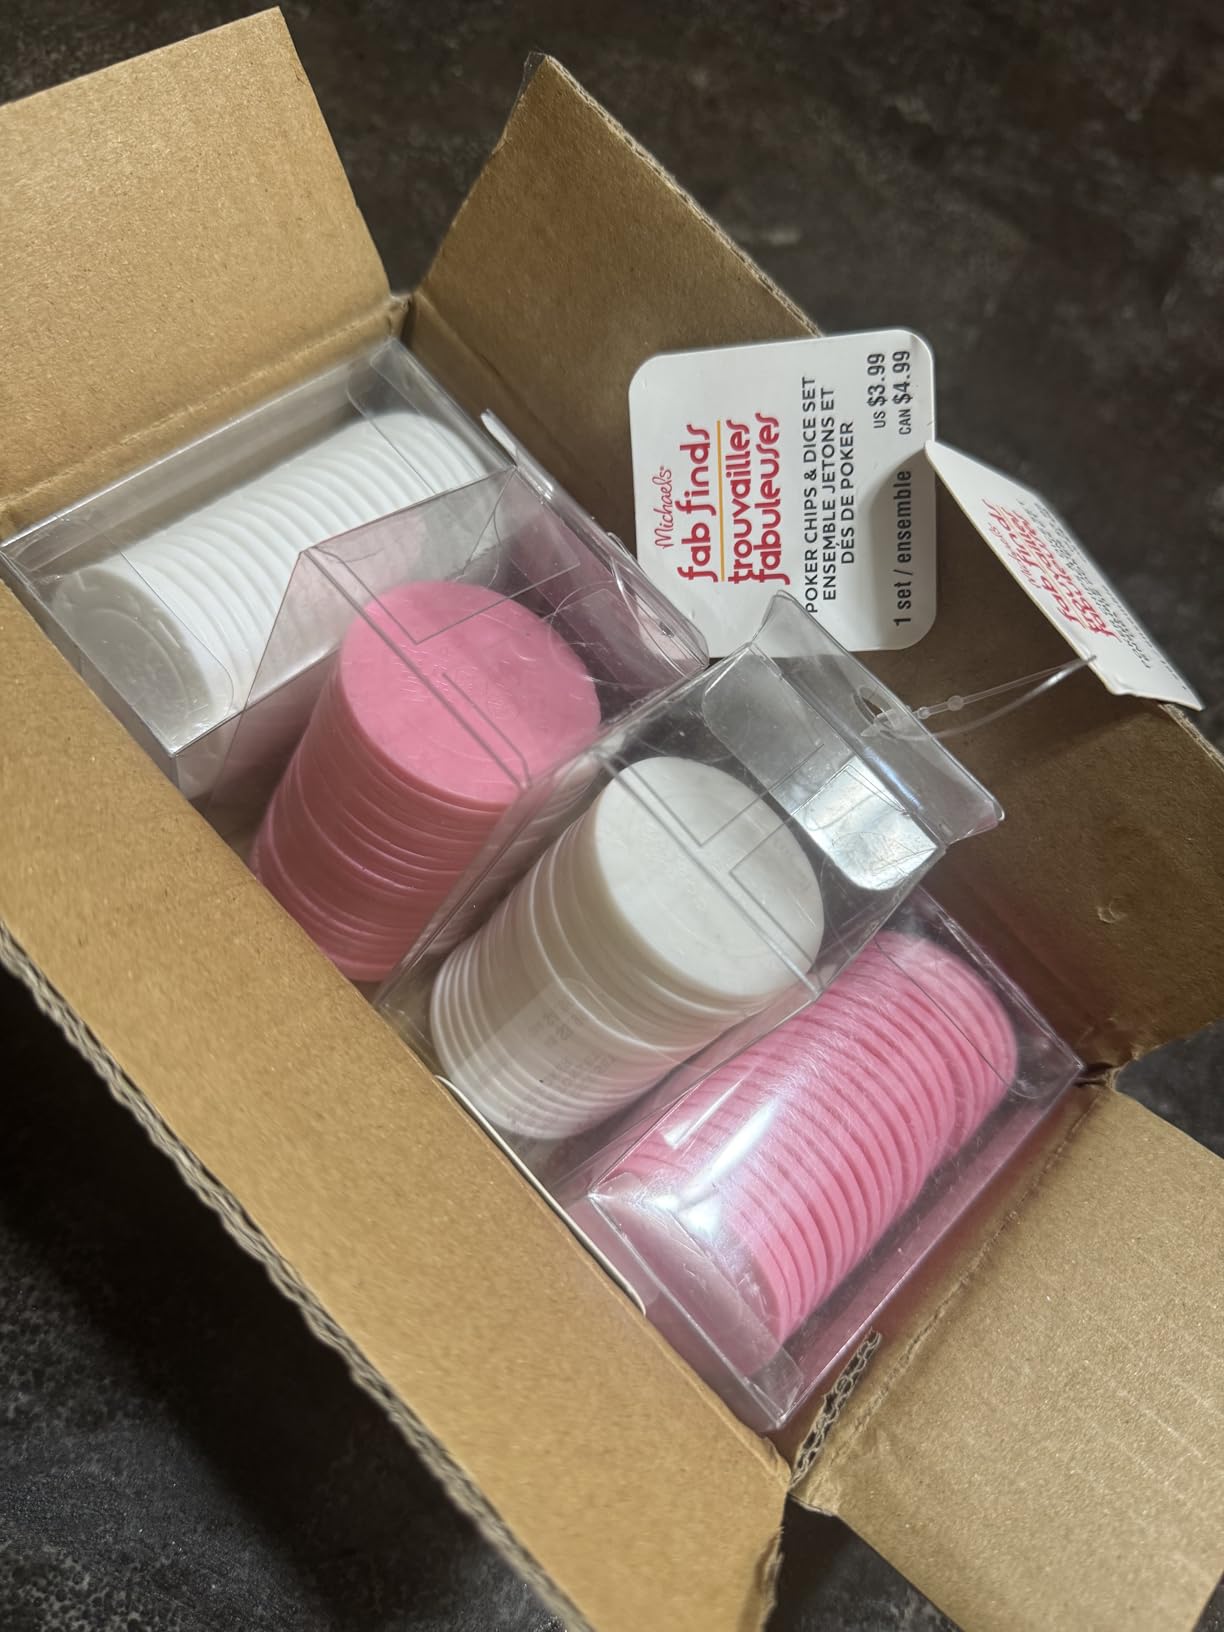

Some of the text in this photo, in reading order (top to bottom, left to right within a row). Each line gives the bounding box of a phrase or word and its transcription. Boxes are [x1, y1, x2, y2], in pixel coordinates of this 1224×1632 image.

[867, 353, 888, 428] US $3.99
[892, 350, 913, 435] CAN $4.99
[652, 466, 674, 549] Michaels
[675, 424, 718, 582] fab finds
[726, 419, 753, 584] trouvailles
[750, 413, 790, 585] fabuleuses
[802, 376, 818, 613] POKER CHIPS & DICE SET
[821, 387, 836, 600] ENSEMBLE JETONS ET
[836, 421, 854, 564] DÉS DE POKER
[893, 471, 911, 563] ensemble
[893, 618, 911, 626] 1
[894, 581, 911, 609] set
